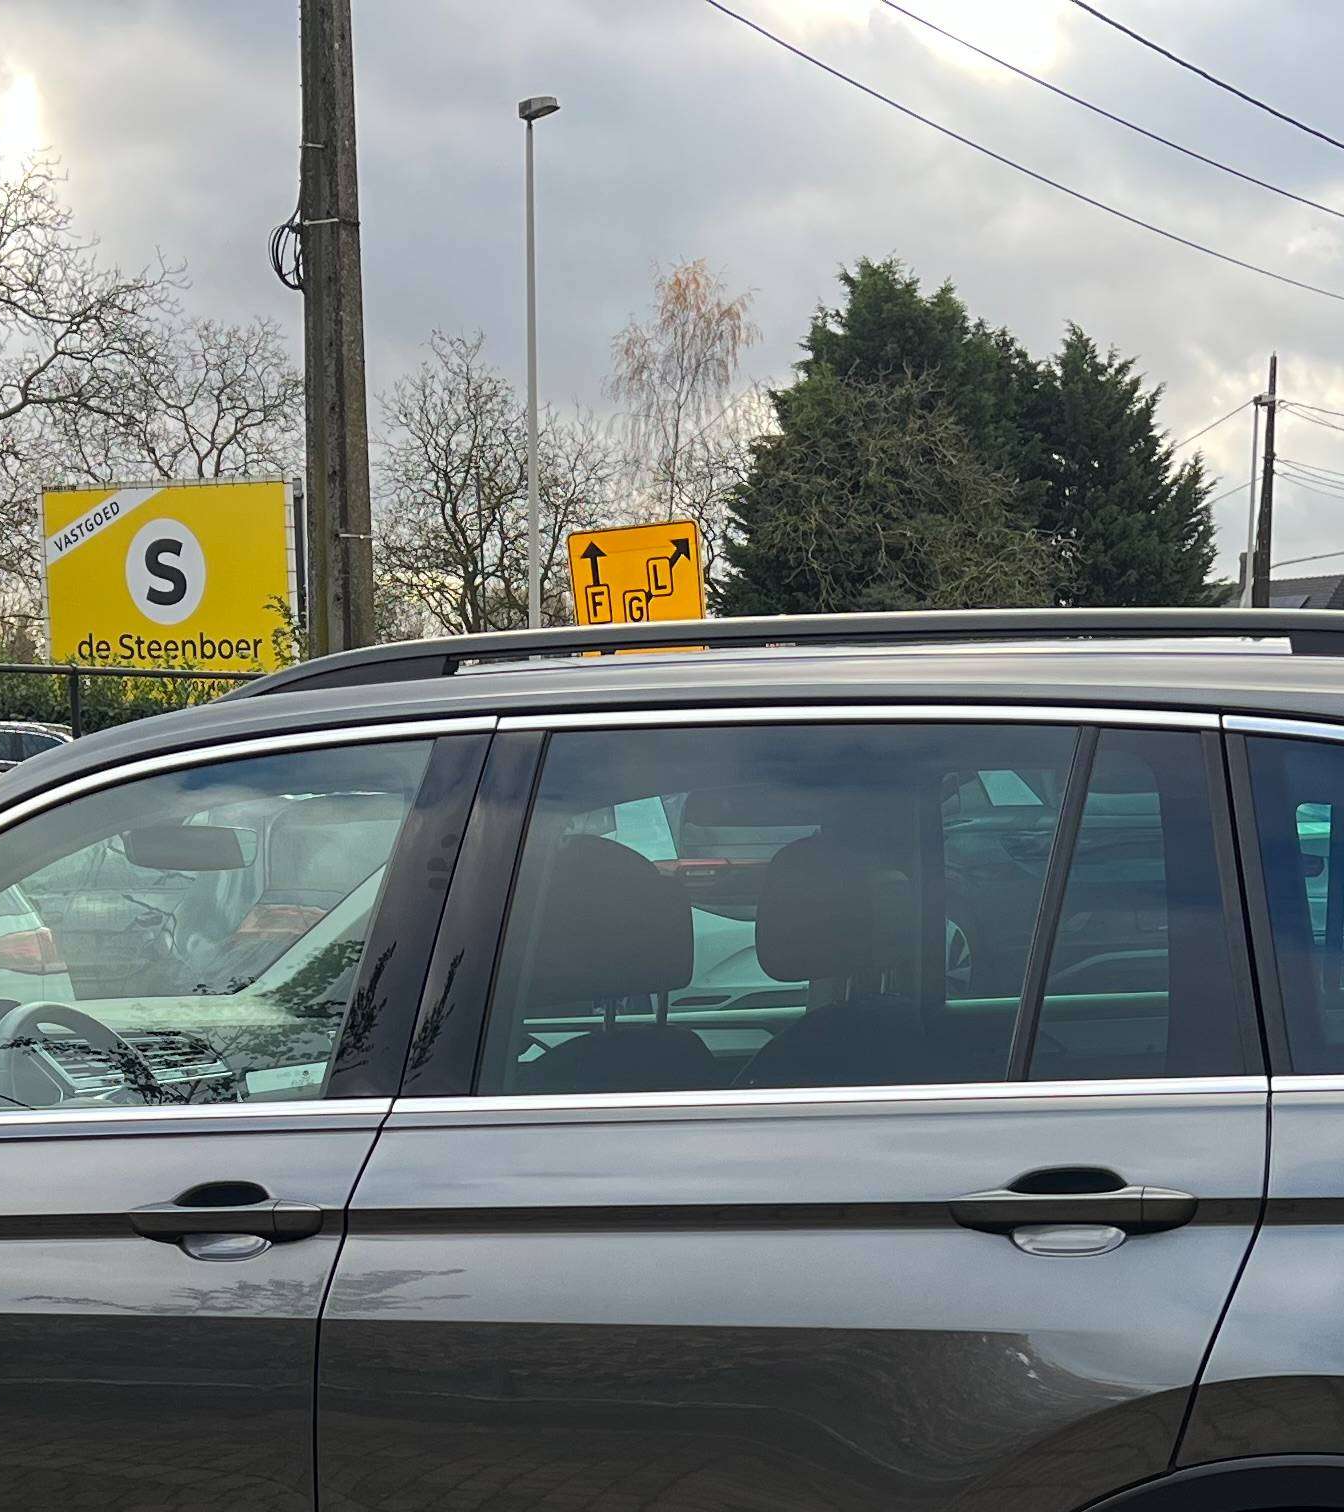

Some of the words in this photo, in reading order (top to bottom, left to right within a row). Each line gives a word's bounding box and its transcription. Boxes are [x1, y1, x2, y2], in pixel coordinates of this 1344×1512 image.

[53, 500, 121, 552] VASTGOED
[144, 538, 187, 606] S
[652, 564, 667, 590] L
[591, 592, 604, 617] F
[629, 595, 644, 622] G
[78, 632, 111, 660] de
[118, 632, 263, 660] Steenboer
